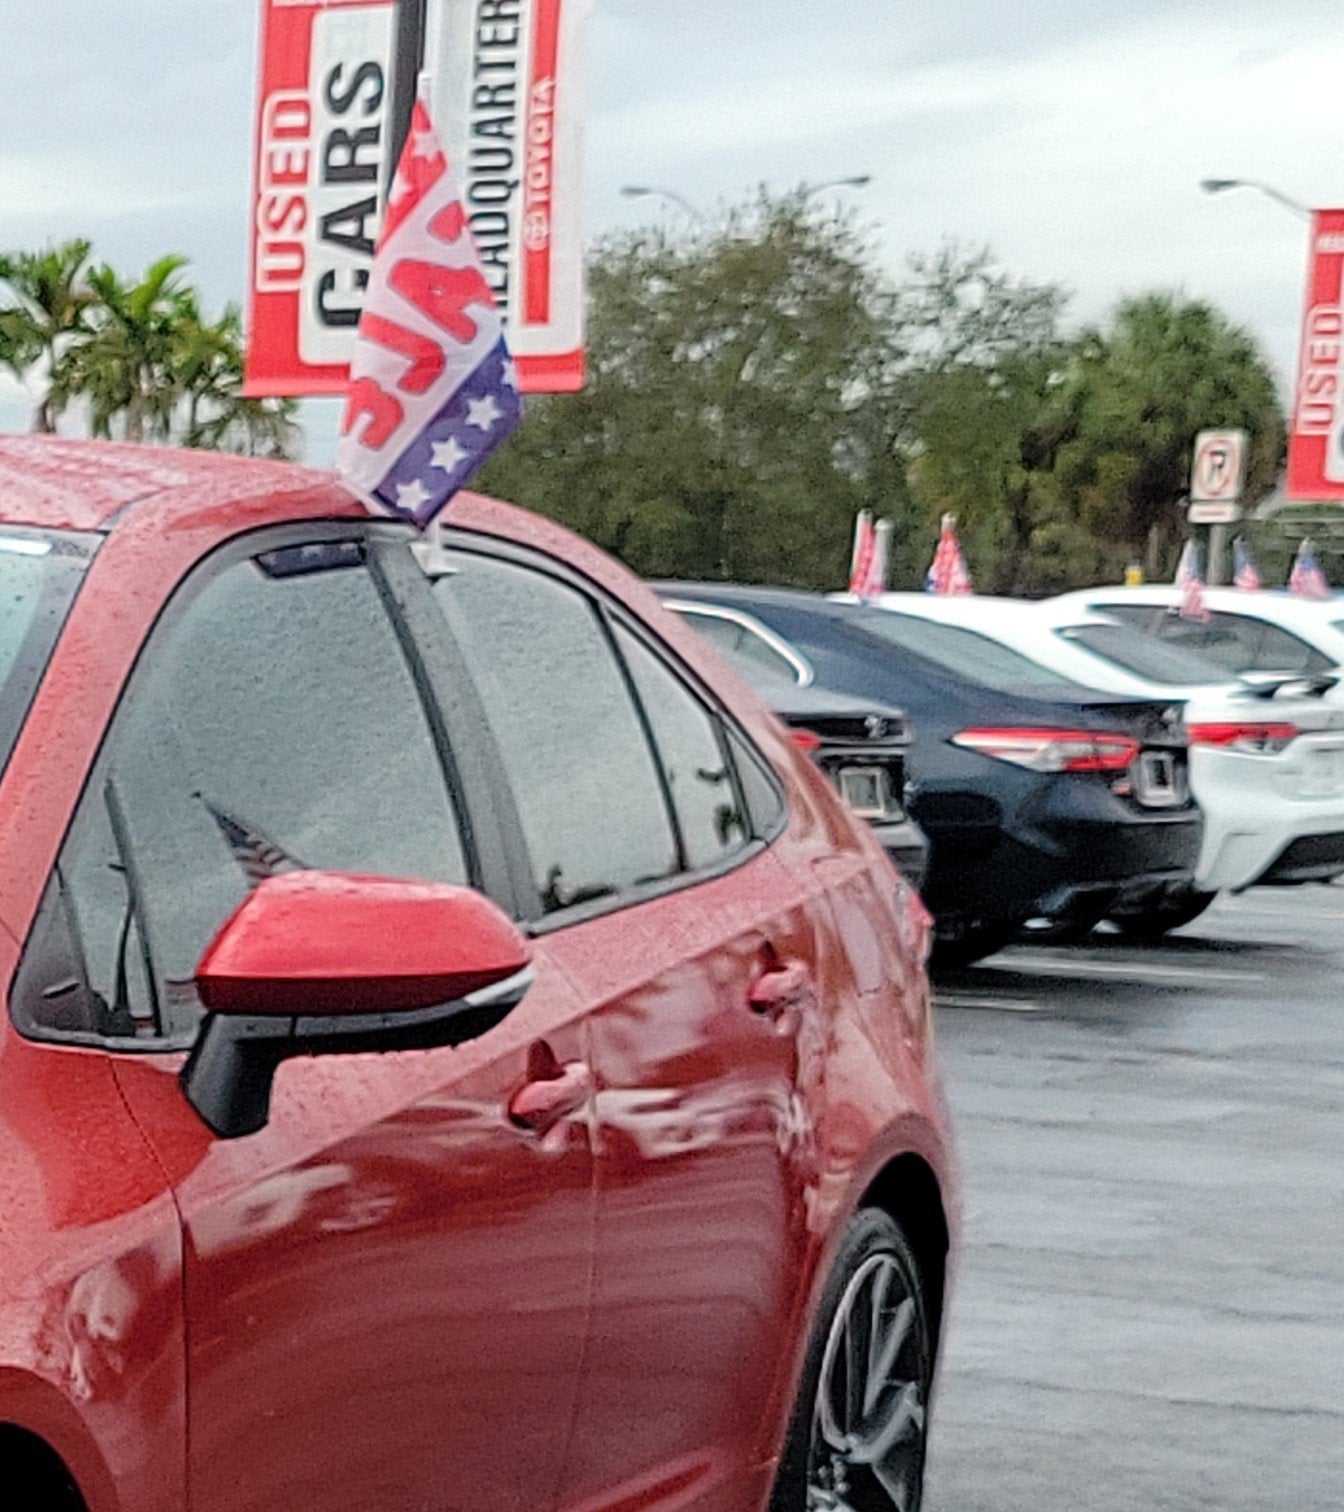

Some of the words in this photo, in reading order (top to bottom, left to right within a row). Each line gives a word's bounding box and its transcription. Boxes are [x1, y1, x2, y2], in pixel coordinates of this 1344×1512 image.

[262, 94, 311, 288] USED
[316, 60, 384, 329] CARS
[466, 0, 521, 326] ADQUARTER
[527, 77, 555, 212] TOYOTA
[1299, 310, 1342, 428] USED
